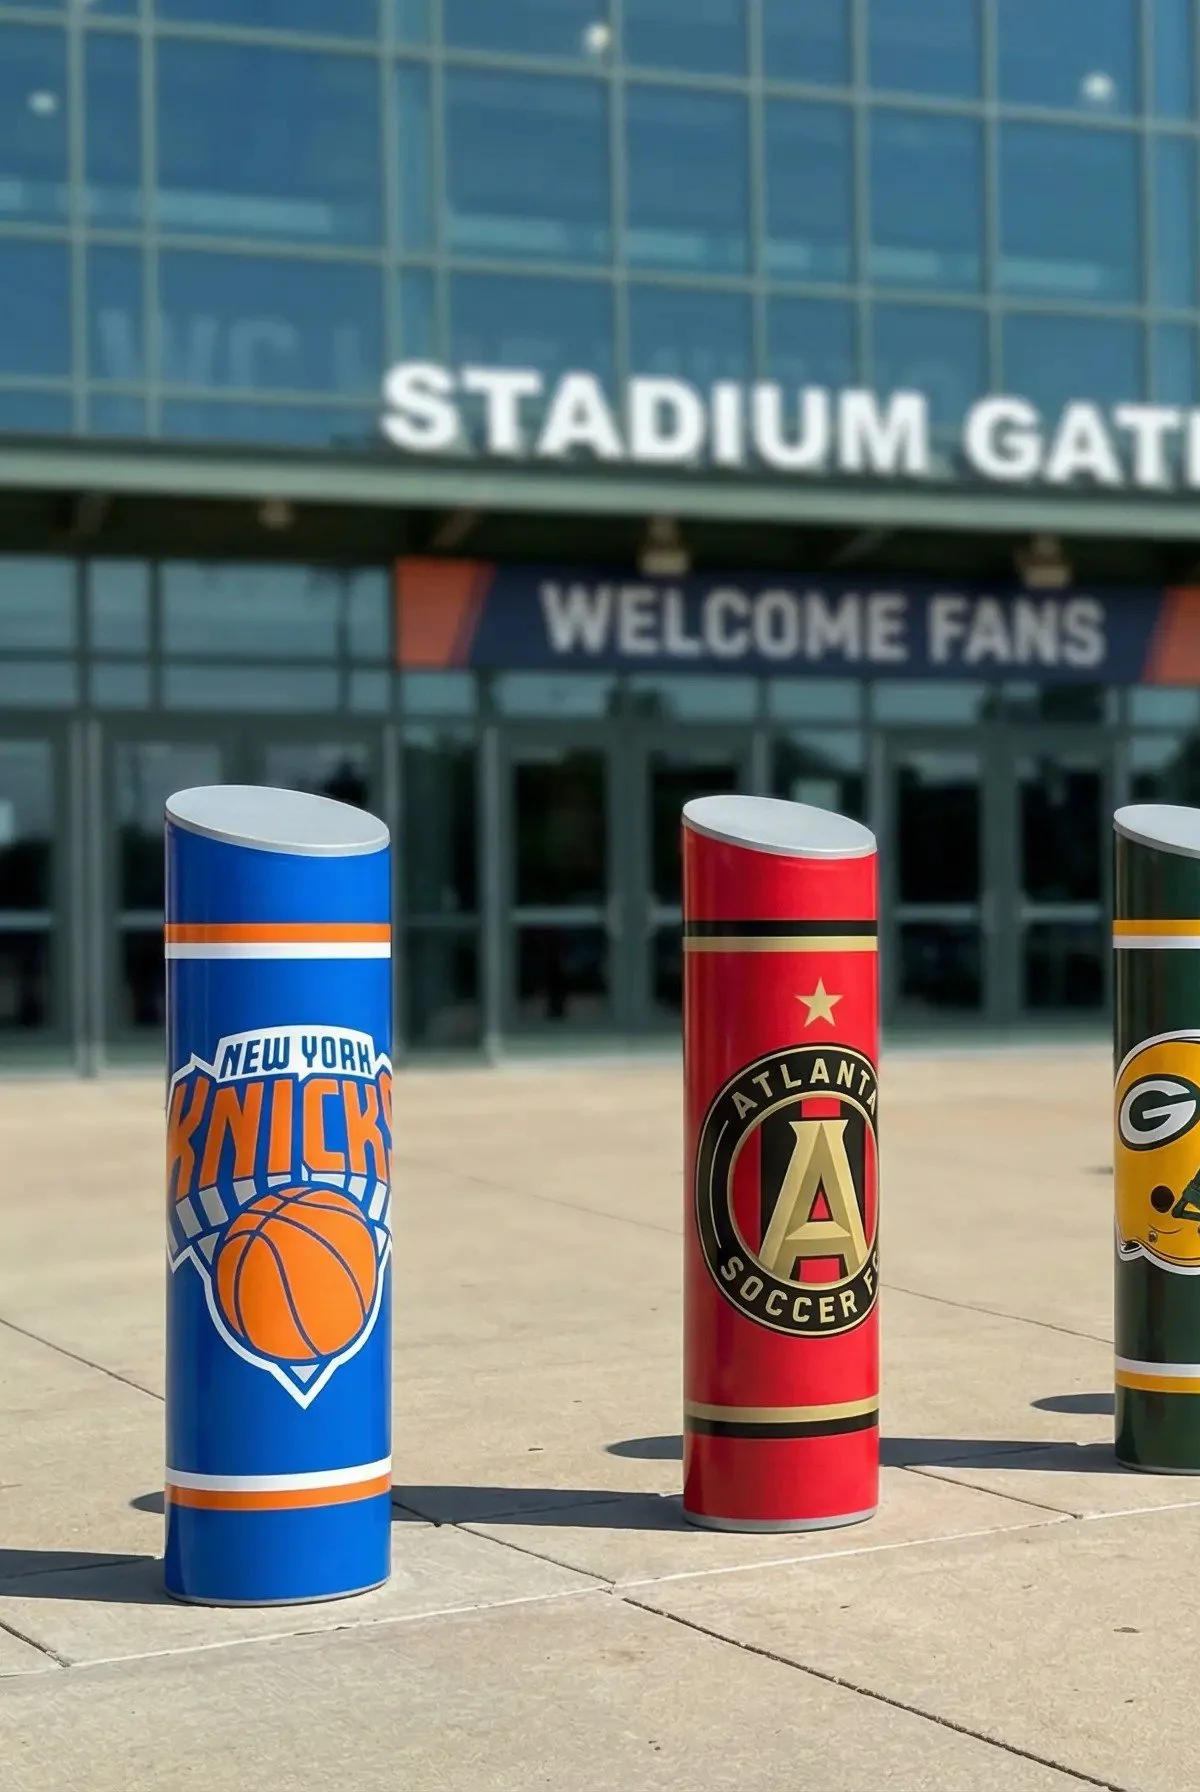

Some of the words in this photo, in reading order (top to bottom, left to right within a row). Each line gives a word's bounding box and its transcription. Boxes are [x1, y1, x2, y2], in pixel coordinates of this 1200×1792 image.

[382, 361, 929, 475] STADIUM
[540, 582, 908, 663] WELCOME
[929, 596, 1106, 669] FANS
[219, 1036, 290, 1079] NEW
[301, 1035, 372, 1075] YORK
[731, 1058, 877, 1120] ATLANTA
[1120, 1080, 1197, 1145] G
[759, 1120, 867, 1281] A
[720, 1256, 857, 1324] SOCCER
